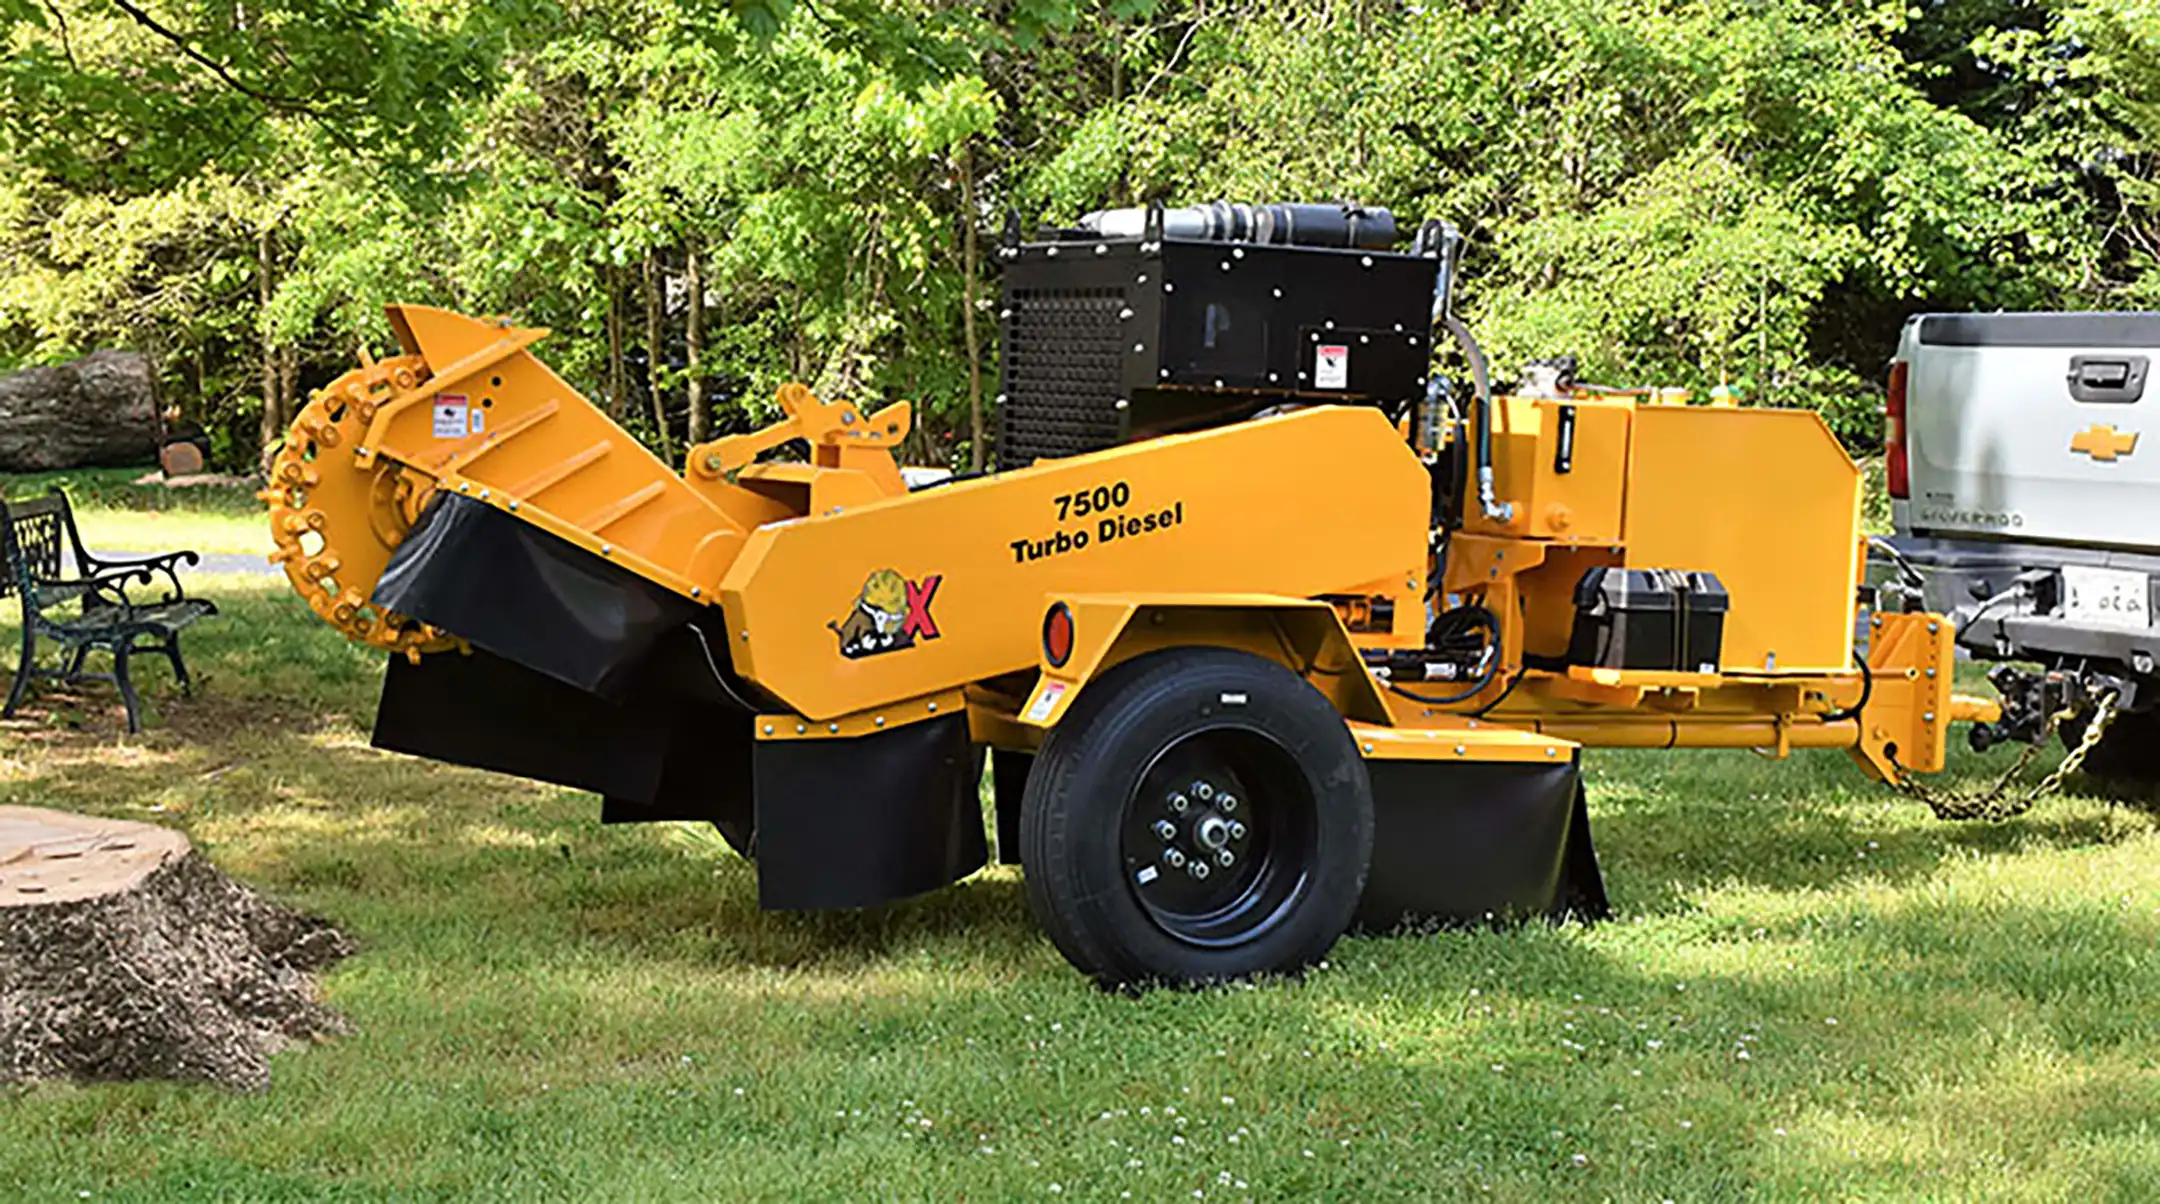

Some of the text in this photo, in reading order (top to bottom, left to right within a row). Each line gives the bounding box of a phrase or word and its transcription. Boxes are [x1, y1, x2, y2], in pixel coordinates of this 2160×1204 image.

[1054, 482, 1130, 521] 7500
[1010, 502, 1183, 563] Turbo Diesel
[902, 574, 943, 640] X
